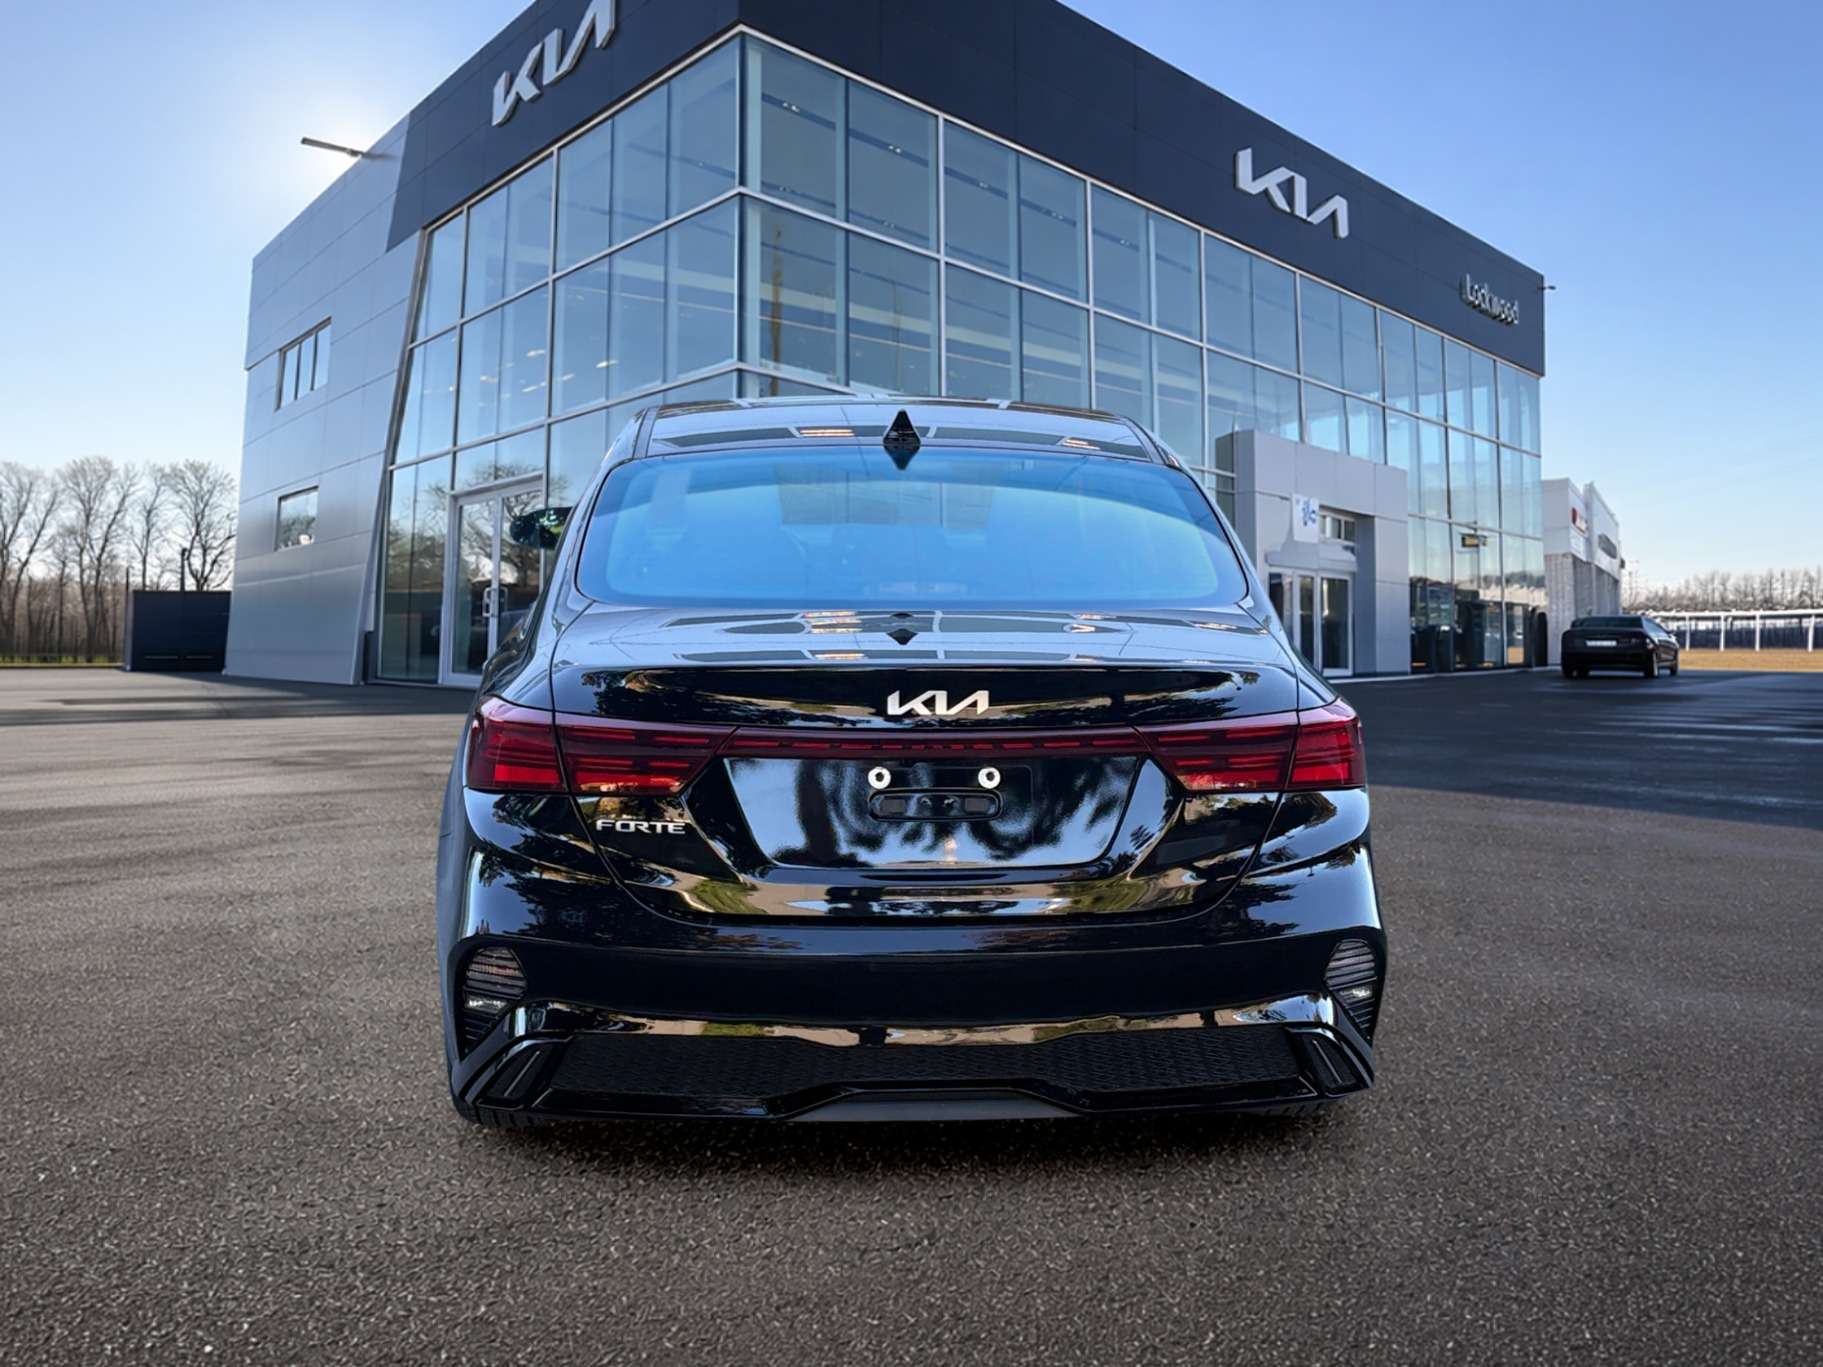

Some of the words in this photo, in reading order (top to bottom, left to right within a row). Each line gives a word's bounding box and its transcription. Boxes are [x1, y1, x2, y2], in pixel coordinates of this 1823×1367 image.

[491, 0, 616, 127] KIA
[1235, 147, 1349, 239] KIA
[887, 690, 989, 715] KIA
[595, 819, 686, 835] FORTE
